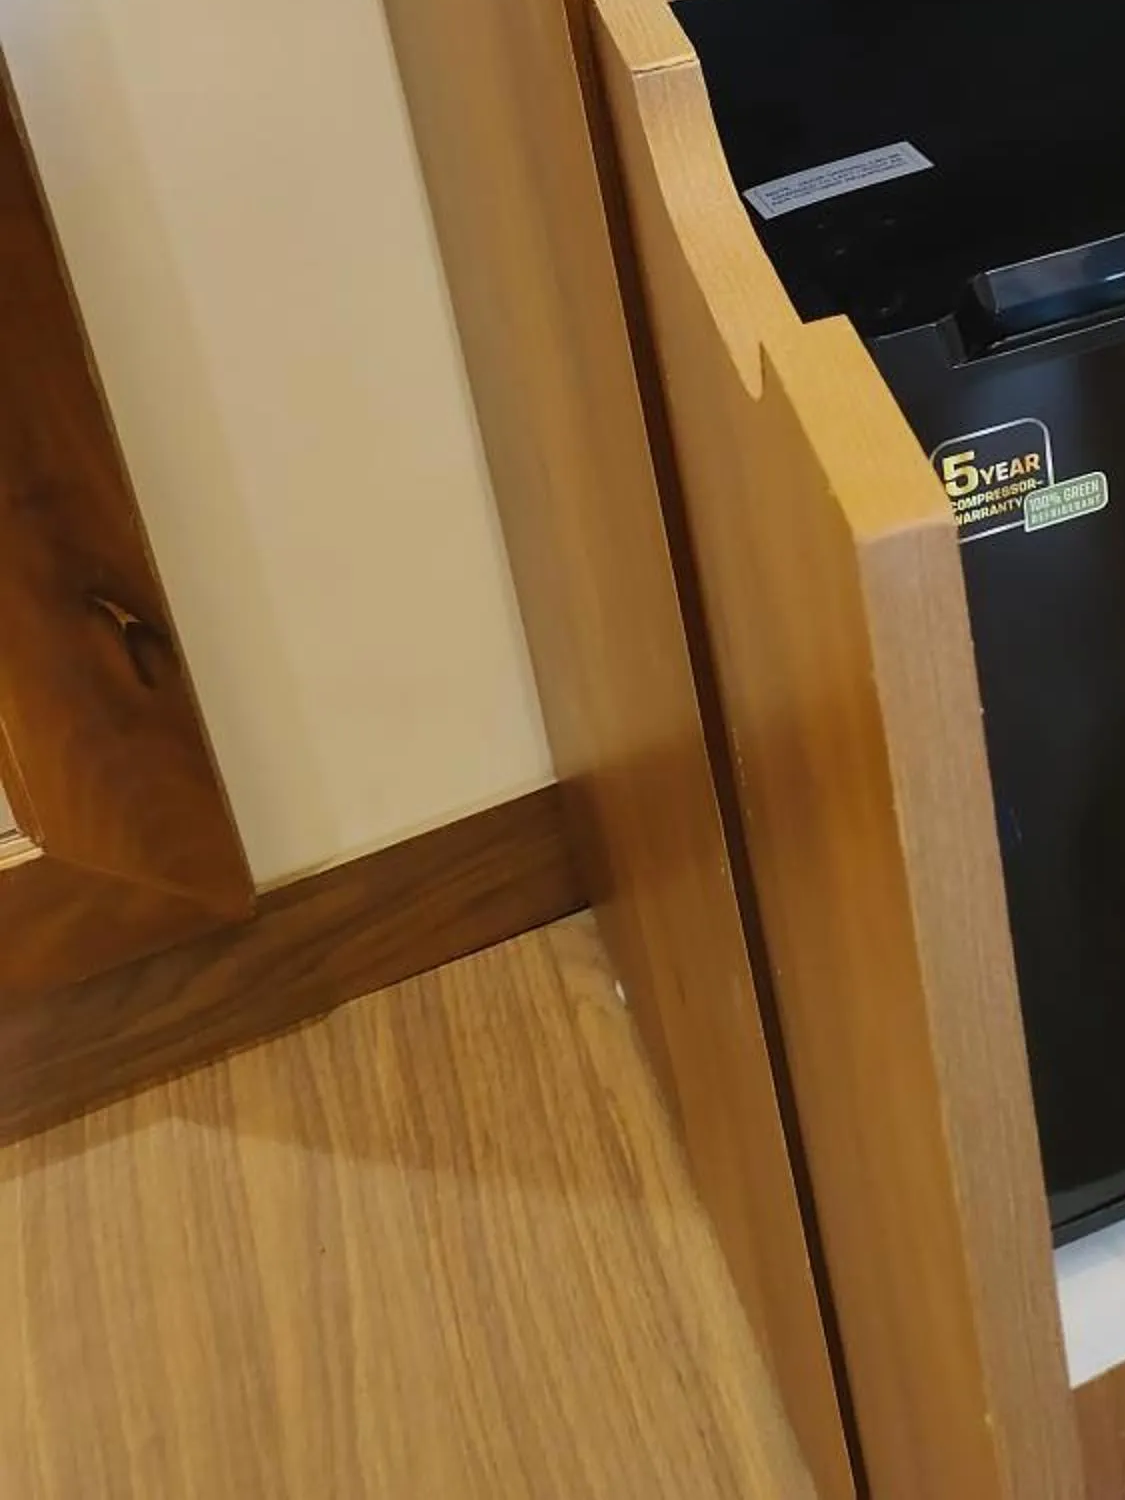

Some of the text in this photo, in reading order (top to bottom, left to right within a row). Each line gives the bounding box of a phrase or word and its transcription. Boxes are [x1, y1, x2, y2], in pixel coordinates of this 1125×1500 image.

[941, 450, 1041, 497] 5 YEAR
[1063, 479, 1099, 501] GREEN
